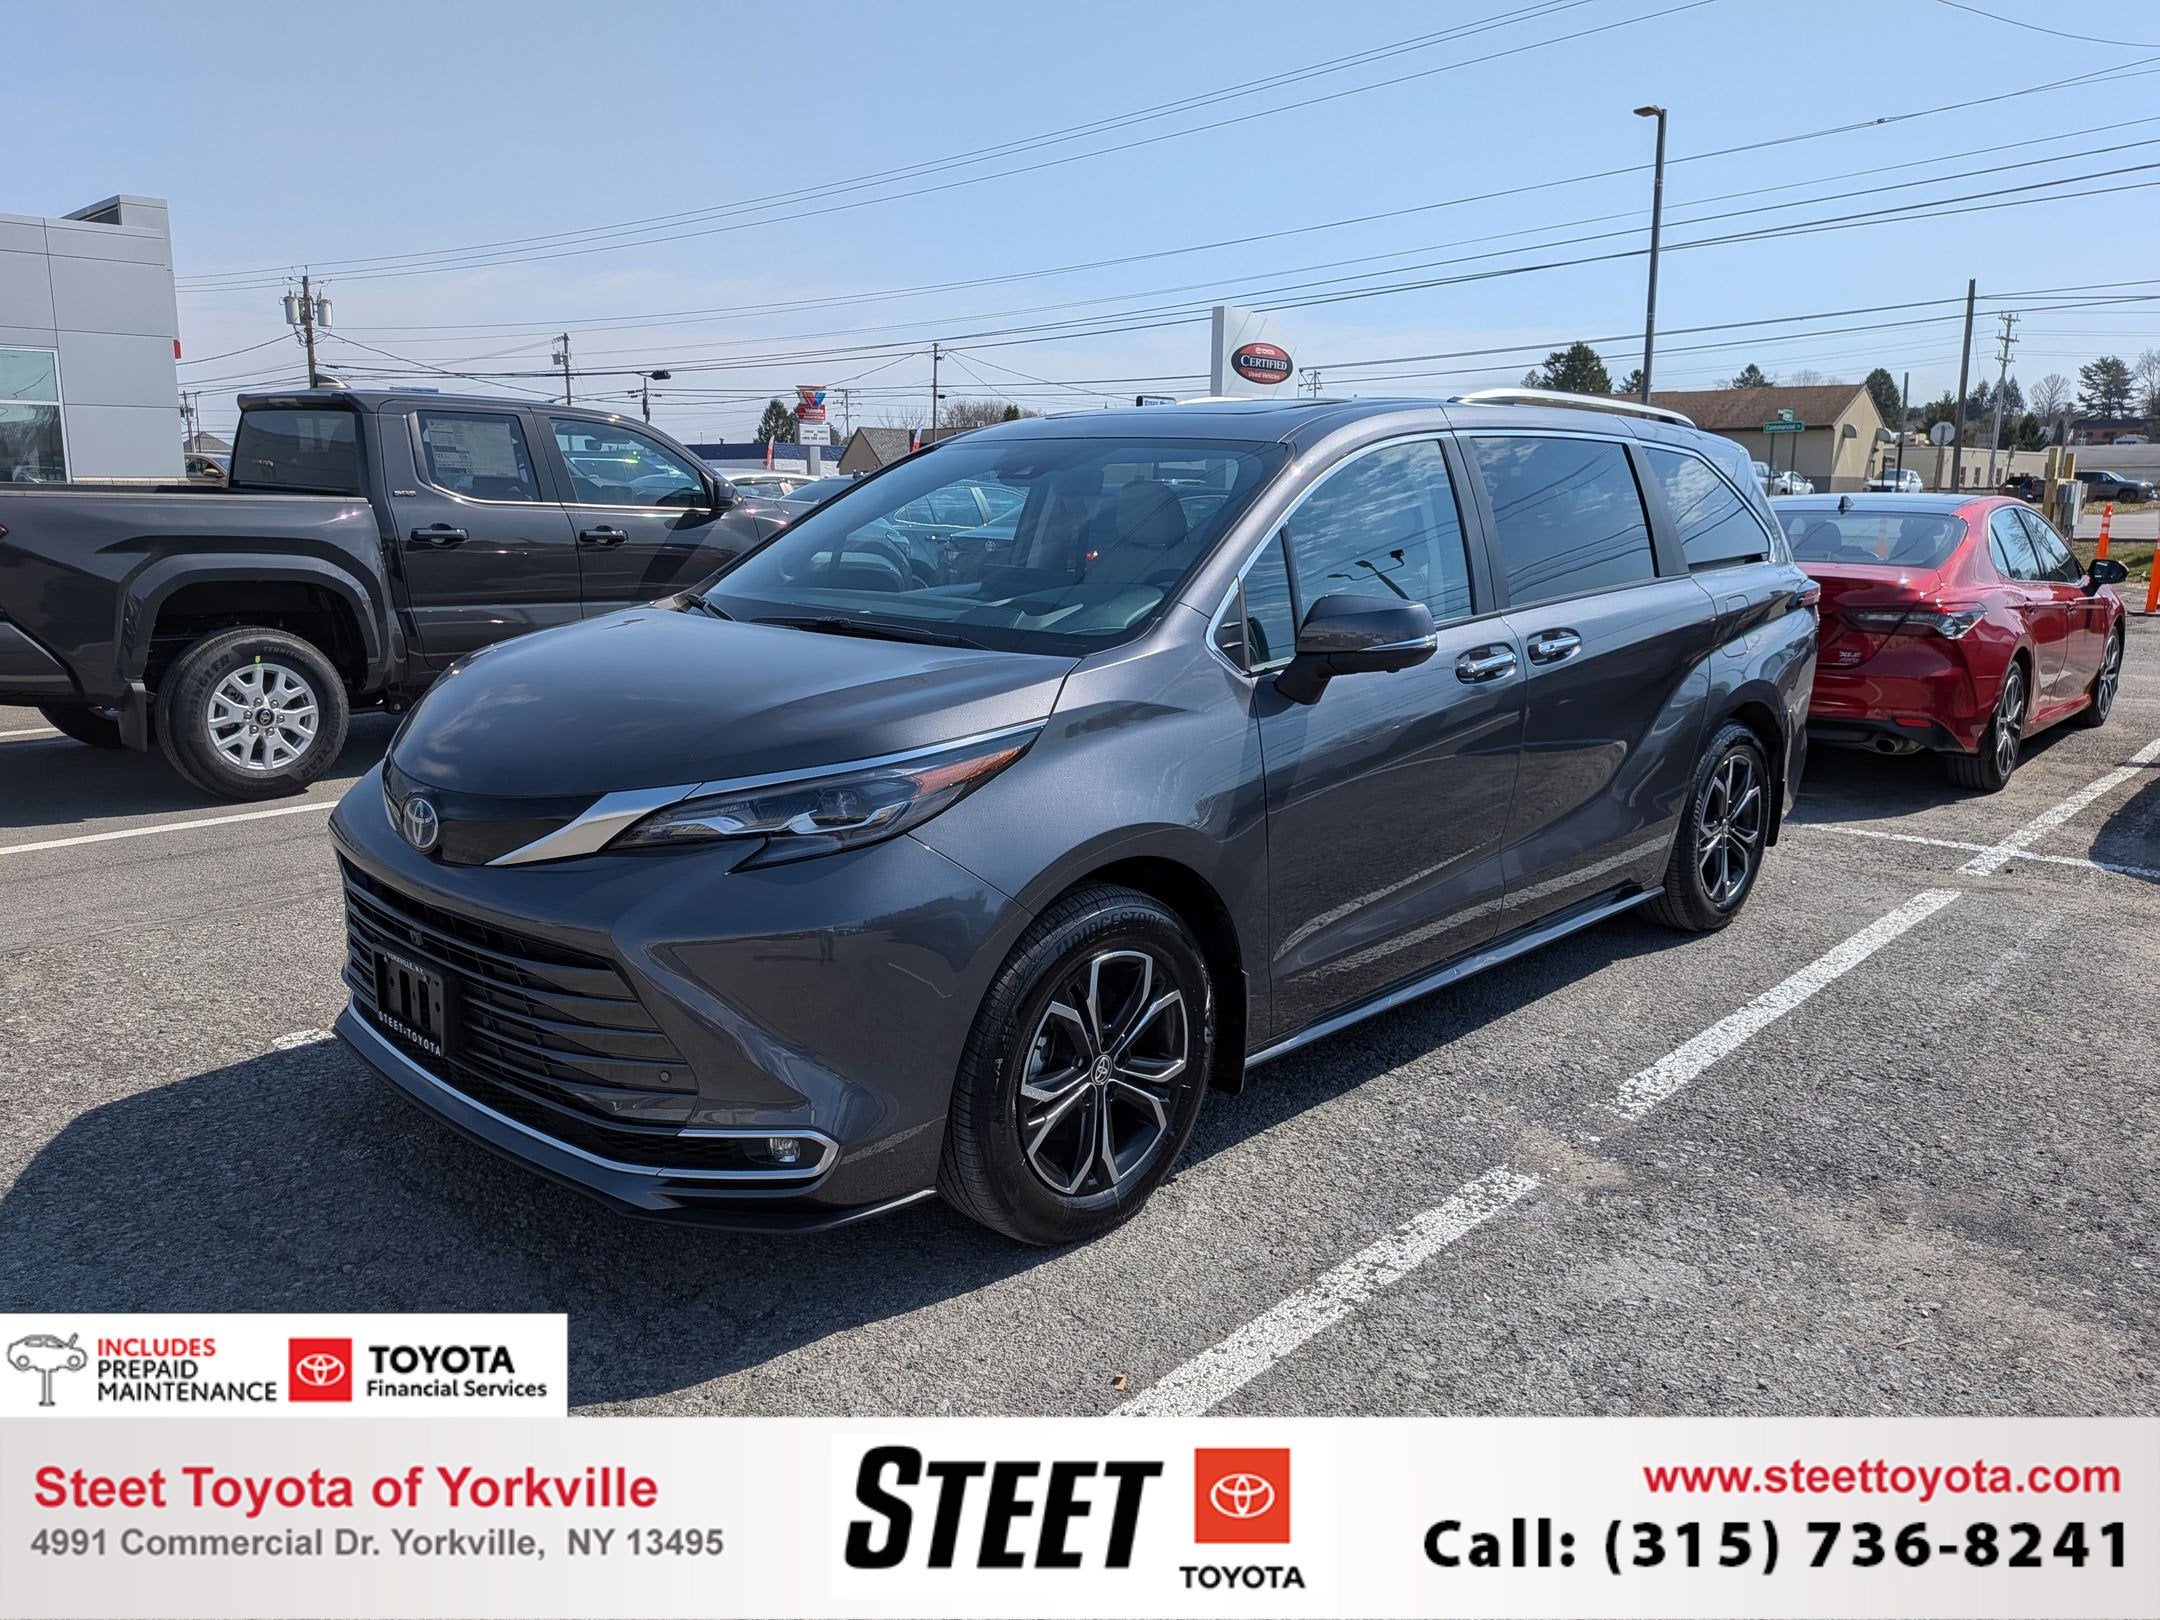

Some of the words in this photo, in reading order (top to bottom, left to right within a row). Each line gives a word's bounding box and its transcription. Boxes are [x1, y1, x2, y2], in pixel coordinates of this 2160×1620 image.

[1240, 355, 1287, 370] CERTIFIED
[1262, 372, 1280, 380] Vehicles
[386, 951, 415, 972] YORKVILLE,
